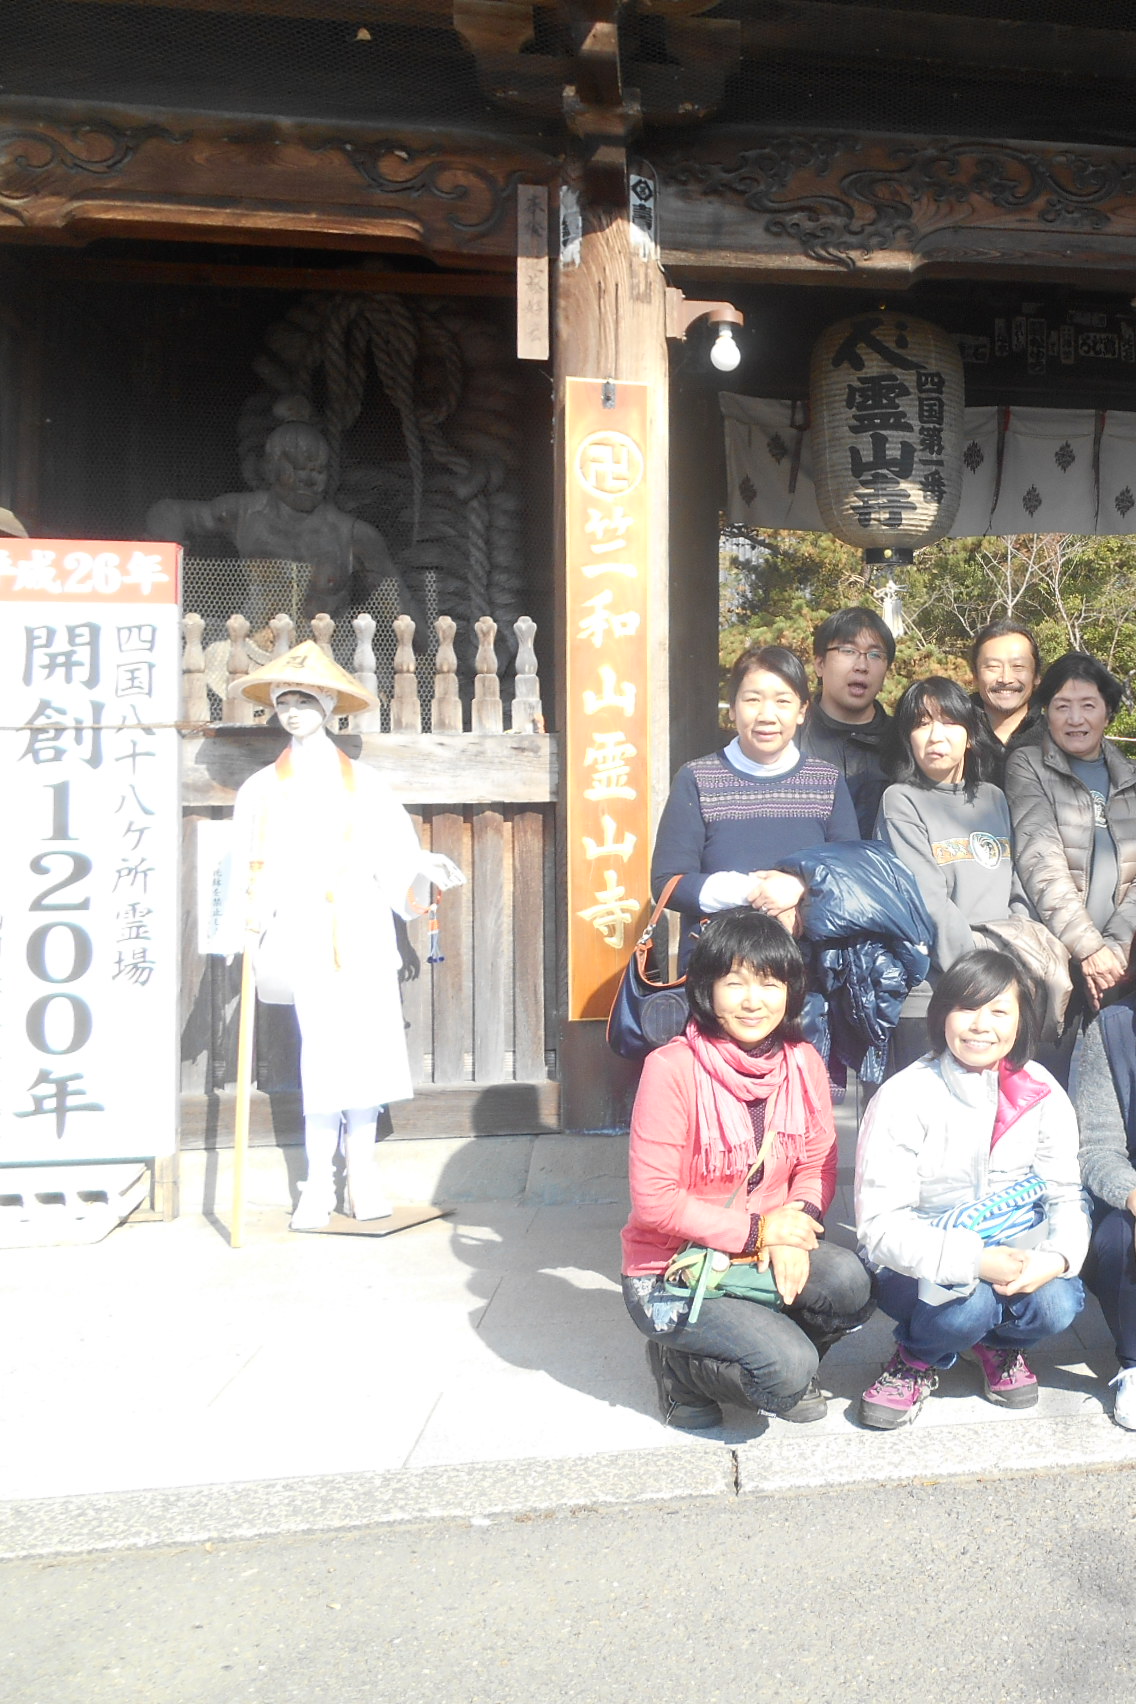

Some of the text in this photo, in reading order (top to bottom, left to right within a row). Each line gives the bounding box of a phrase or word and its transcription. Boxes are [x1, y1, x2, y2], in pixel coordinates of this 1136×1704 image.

[917, 371, 947, 504] 四国第一番
[13, 621, 106, 1140] 開創1200年
